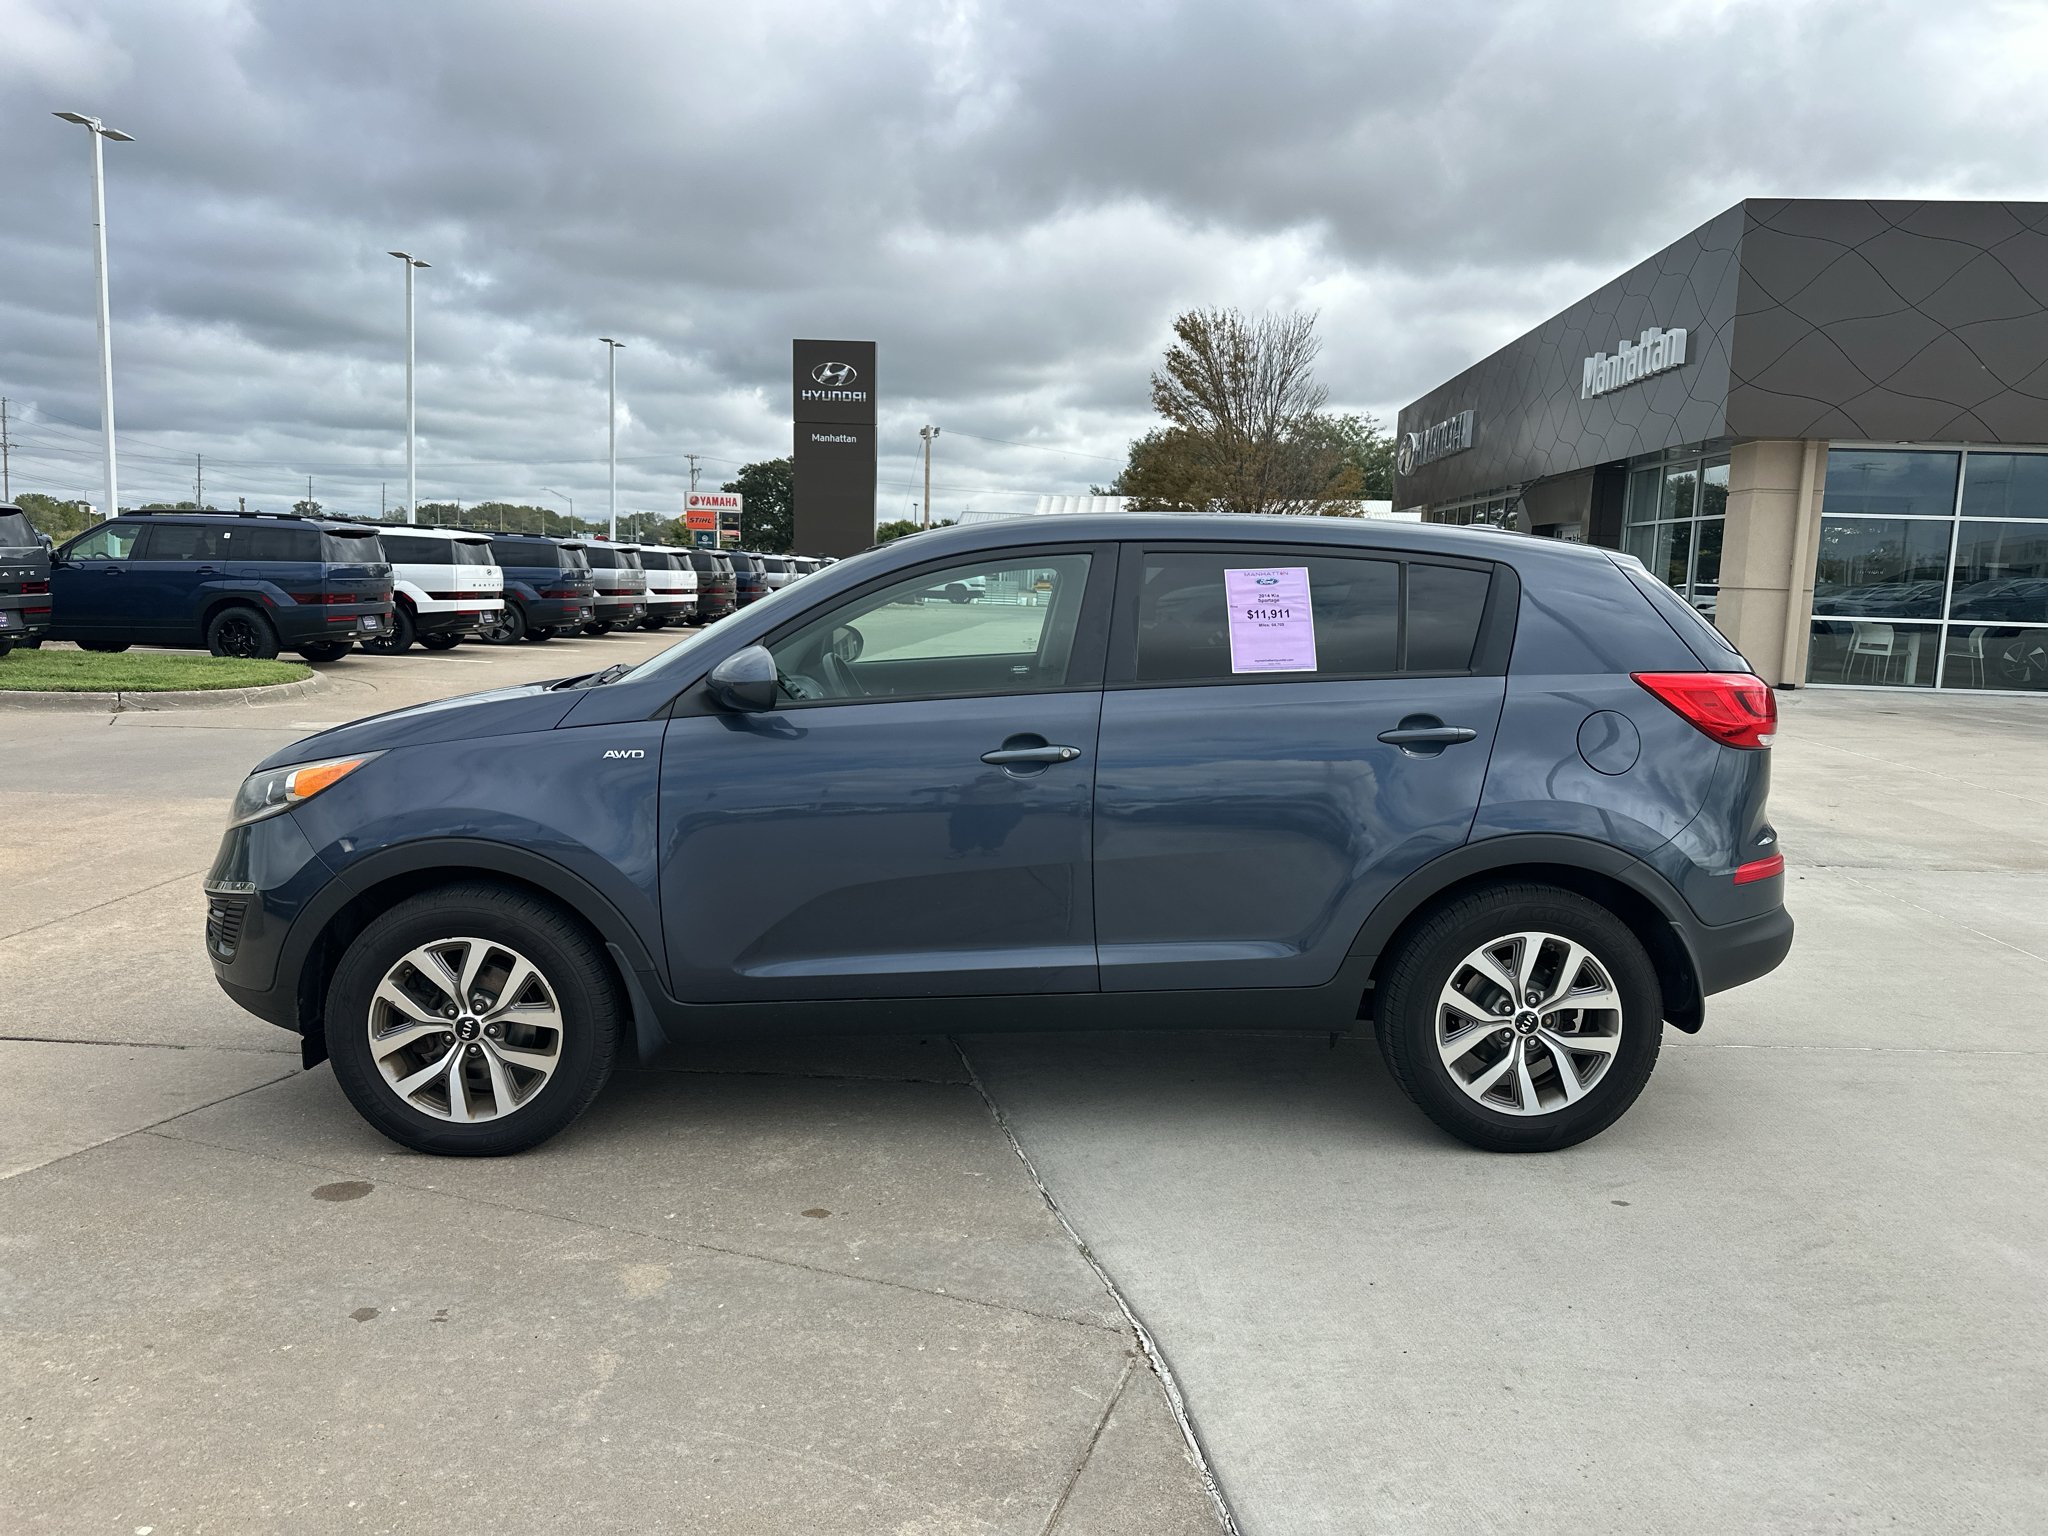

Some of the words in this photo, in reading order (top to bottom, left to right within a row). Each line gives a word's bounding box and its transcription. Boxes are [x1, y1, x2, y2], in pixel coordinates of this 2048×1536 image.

[1582, 327, 1687, 400] Manhattan
[802, 390, 867, 402] HYUNDAI
[811, 433, 857, 443] Manhattan
[700, 496, 738, 507] YAMAHA
[689, 516, 712, 524] STIHL
[1247, 609, 1290, 620] $11,911
[602, 749, 645, 759] AWD
[1519, 1015, 1535, 1032] KIA
[461, 1020, 474, 1039] KIA
